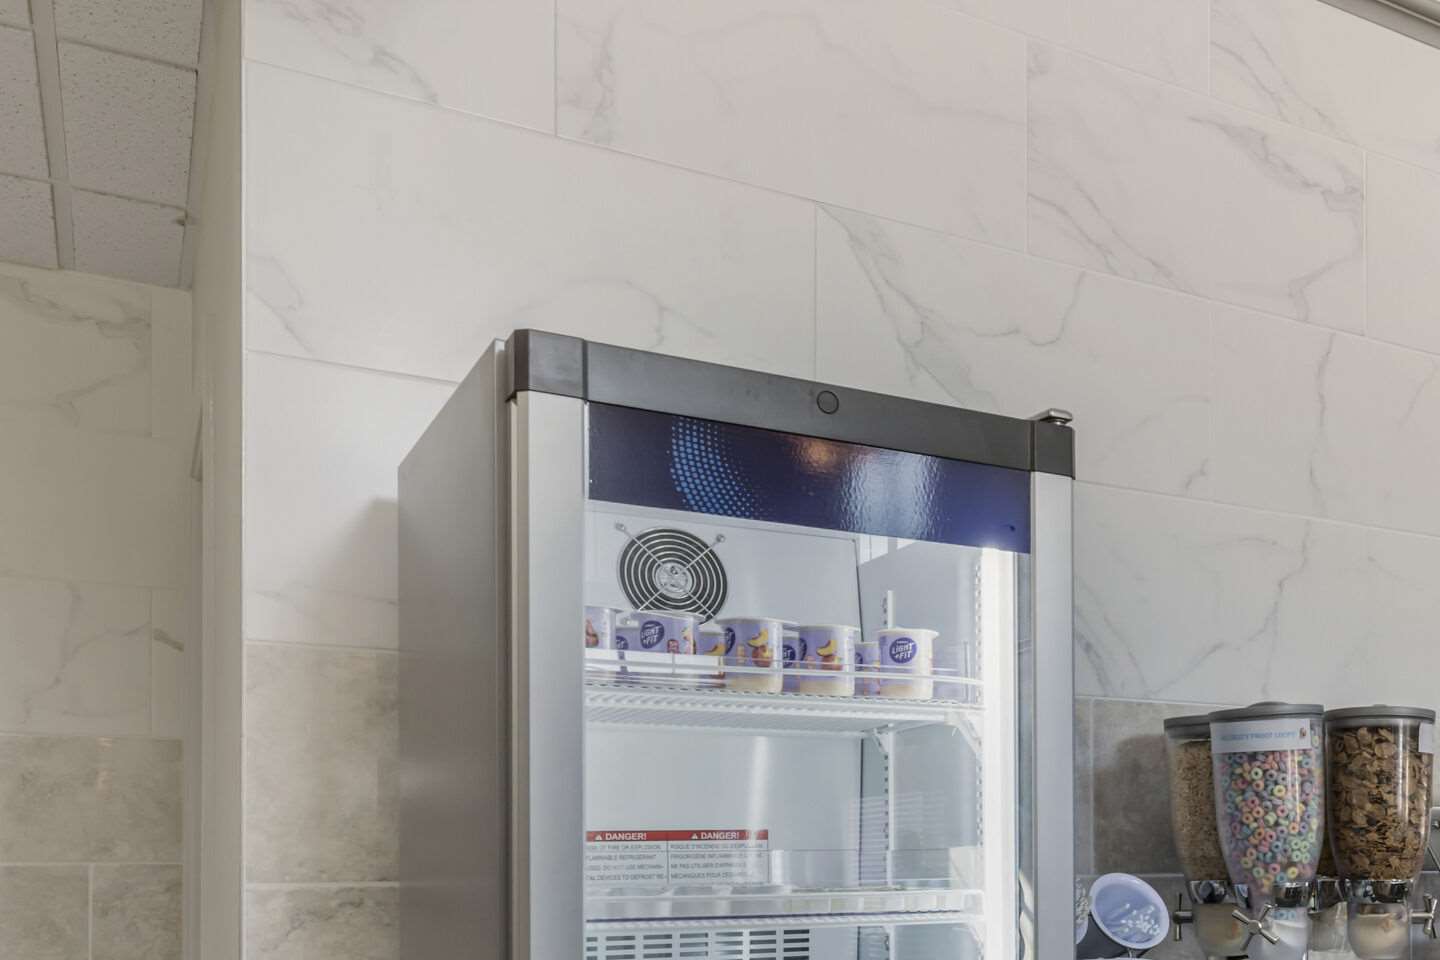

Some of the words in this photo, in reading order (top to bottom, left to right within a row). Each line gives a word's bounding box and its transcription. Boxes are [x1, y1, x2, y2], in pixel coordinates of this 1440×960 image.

[891, 643, 914, 654] LIGHT
[605, 832, 647, 841] DANGER!
[700, 831, 740, 840] DANGER!
